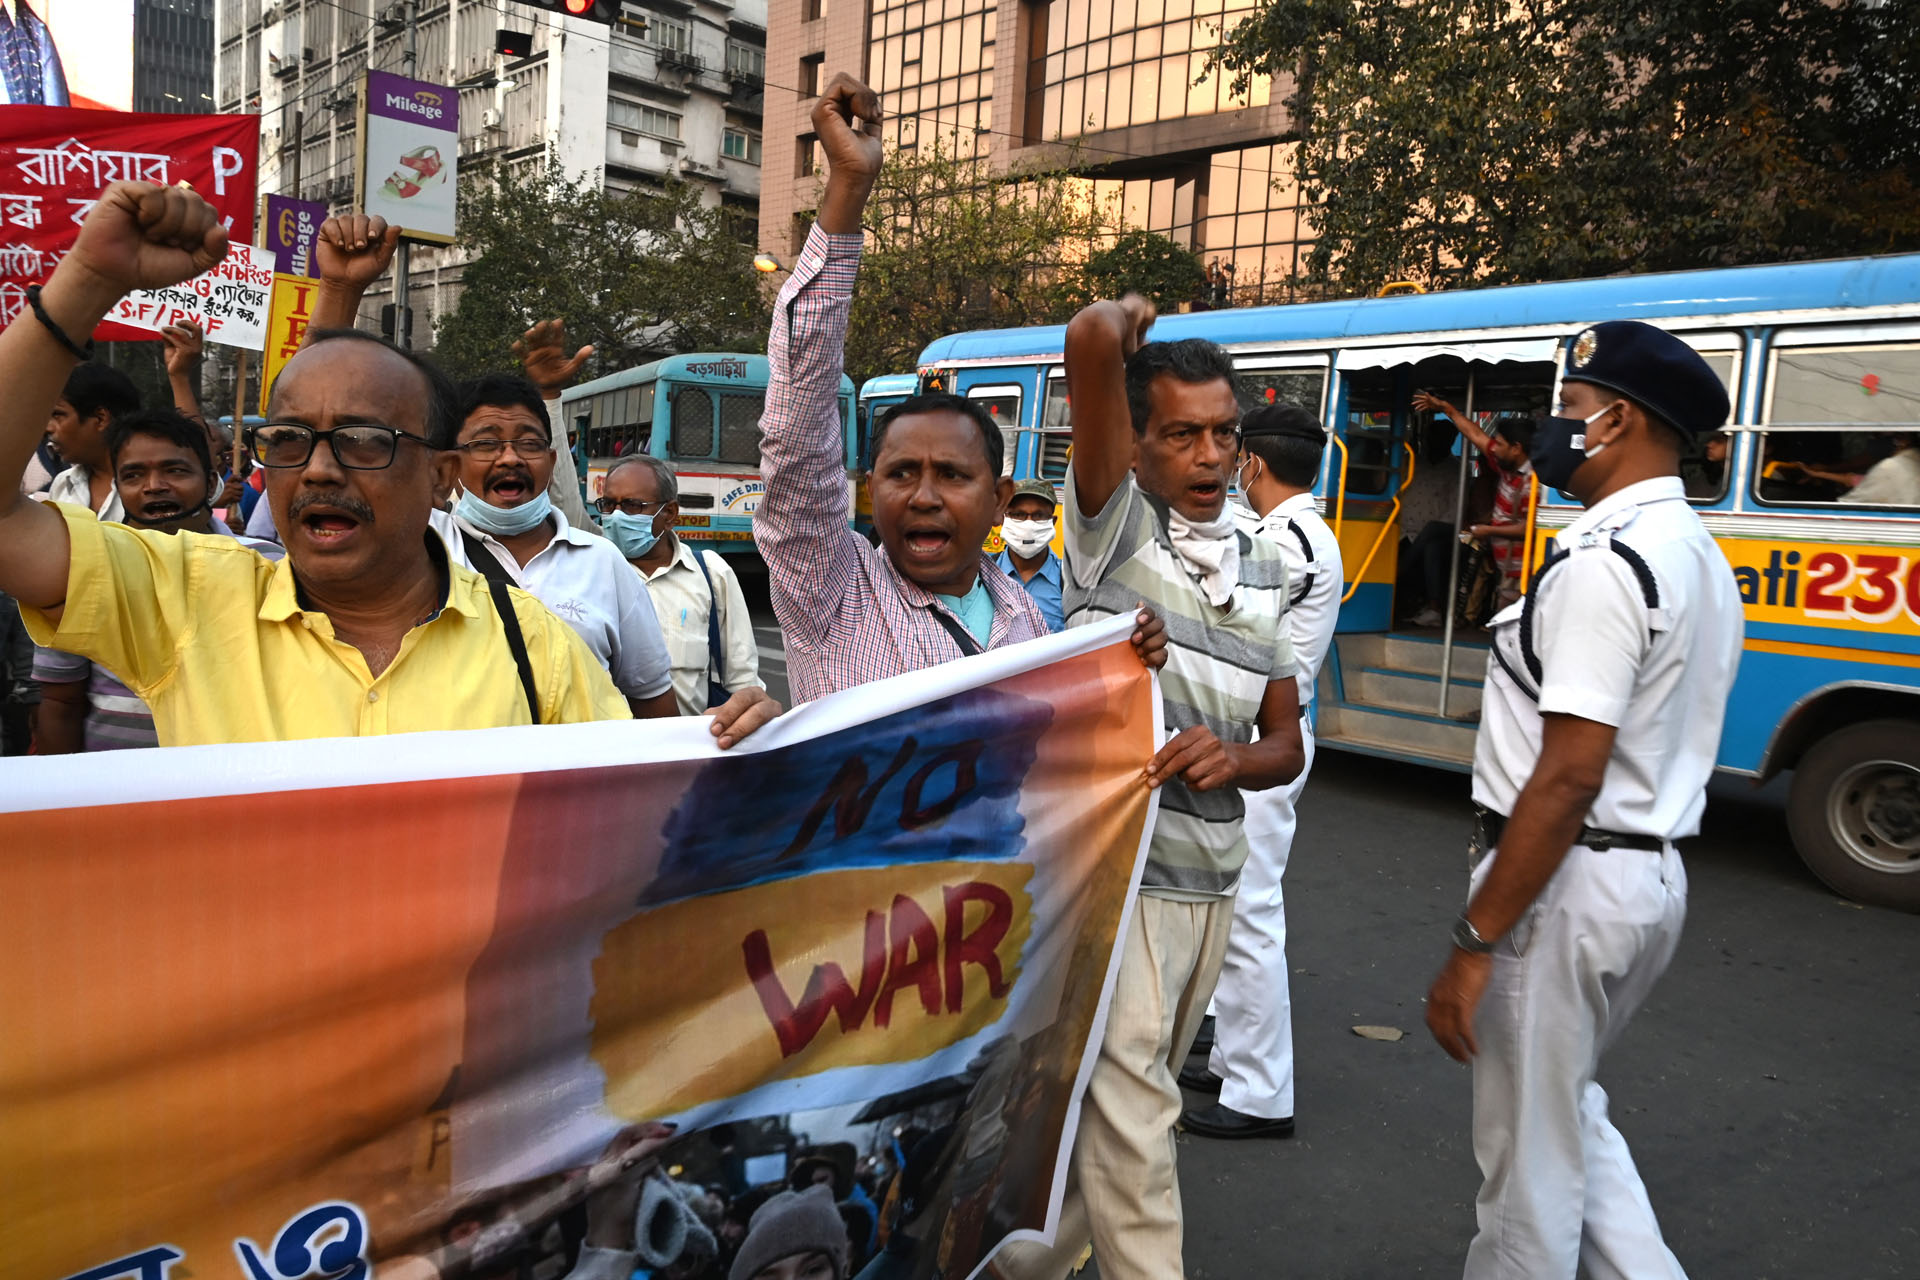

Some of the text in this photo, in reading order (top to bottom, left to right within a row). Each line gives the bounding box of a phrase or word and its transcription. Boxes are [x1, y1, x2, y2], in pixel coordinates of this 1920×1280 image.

[386, 93, 443, 120] Mileage
[722, 487, 744, 507] SAFE
[744, 502, 759, 511] LI
[775, 735, 985, 862] NO
[741, 882, 1014, 1059] WAR
